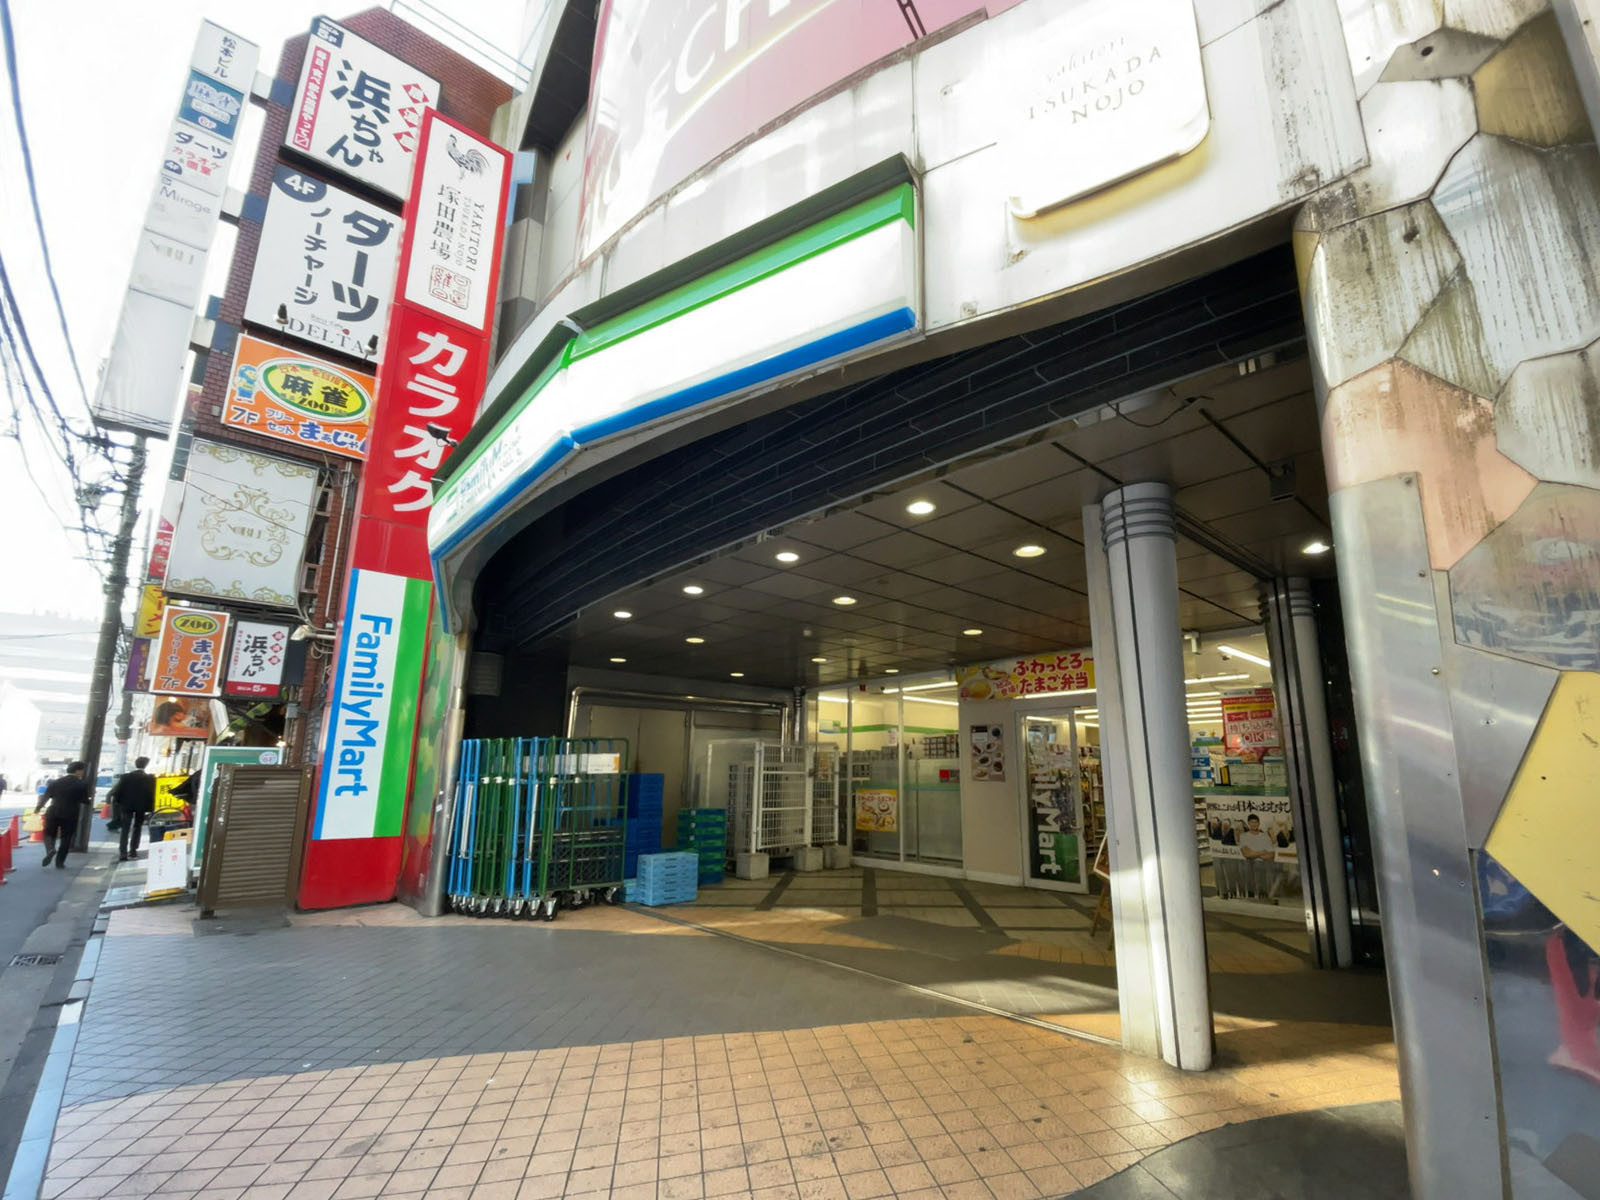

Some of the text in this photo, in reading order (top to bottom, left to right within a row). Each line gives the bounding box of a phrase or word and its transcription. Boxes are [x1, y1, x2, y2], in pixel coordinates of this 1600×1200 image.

[214, 36, 236, 78] 松本ビル
[327, 59, 391, 167] 浜ちゃん
[1071, 79, 1144, 124] NOJO
[284, 174, 316, 195] 4F
[294, 207, 331, 305] ノーチャージ
[466, 202, 485, 272] YAKITORI
[332, 210, 394, 322] ダーツ
[288, 317, 365, 354] DELTA
[281, 373, 350, 409] 麻雀
[231, 406, 258, 424] 7F
[266, 408, 294, 422] フリー
[179, 617, 214, 630] ZOO
[242, 634, 268, 677] 浜ちゃん
[160, 676, 181, 689] 7F
[1020, 672, 1089, 694] たまご弁当
[334, 613, 393, 797] FamilyMart
